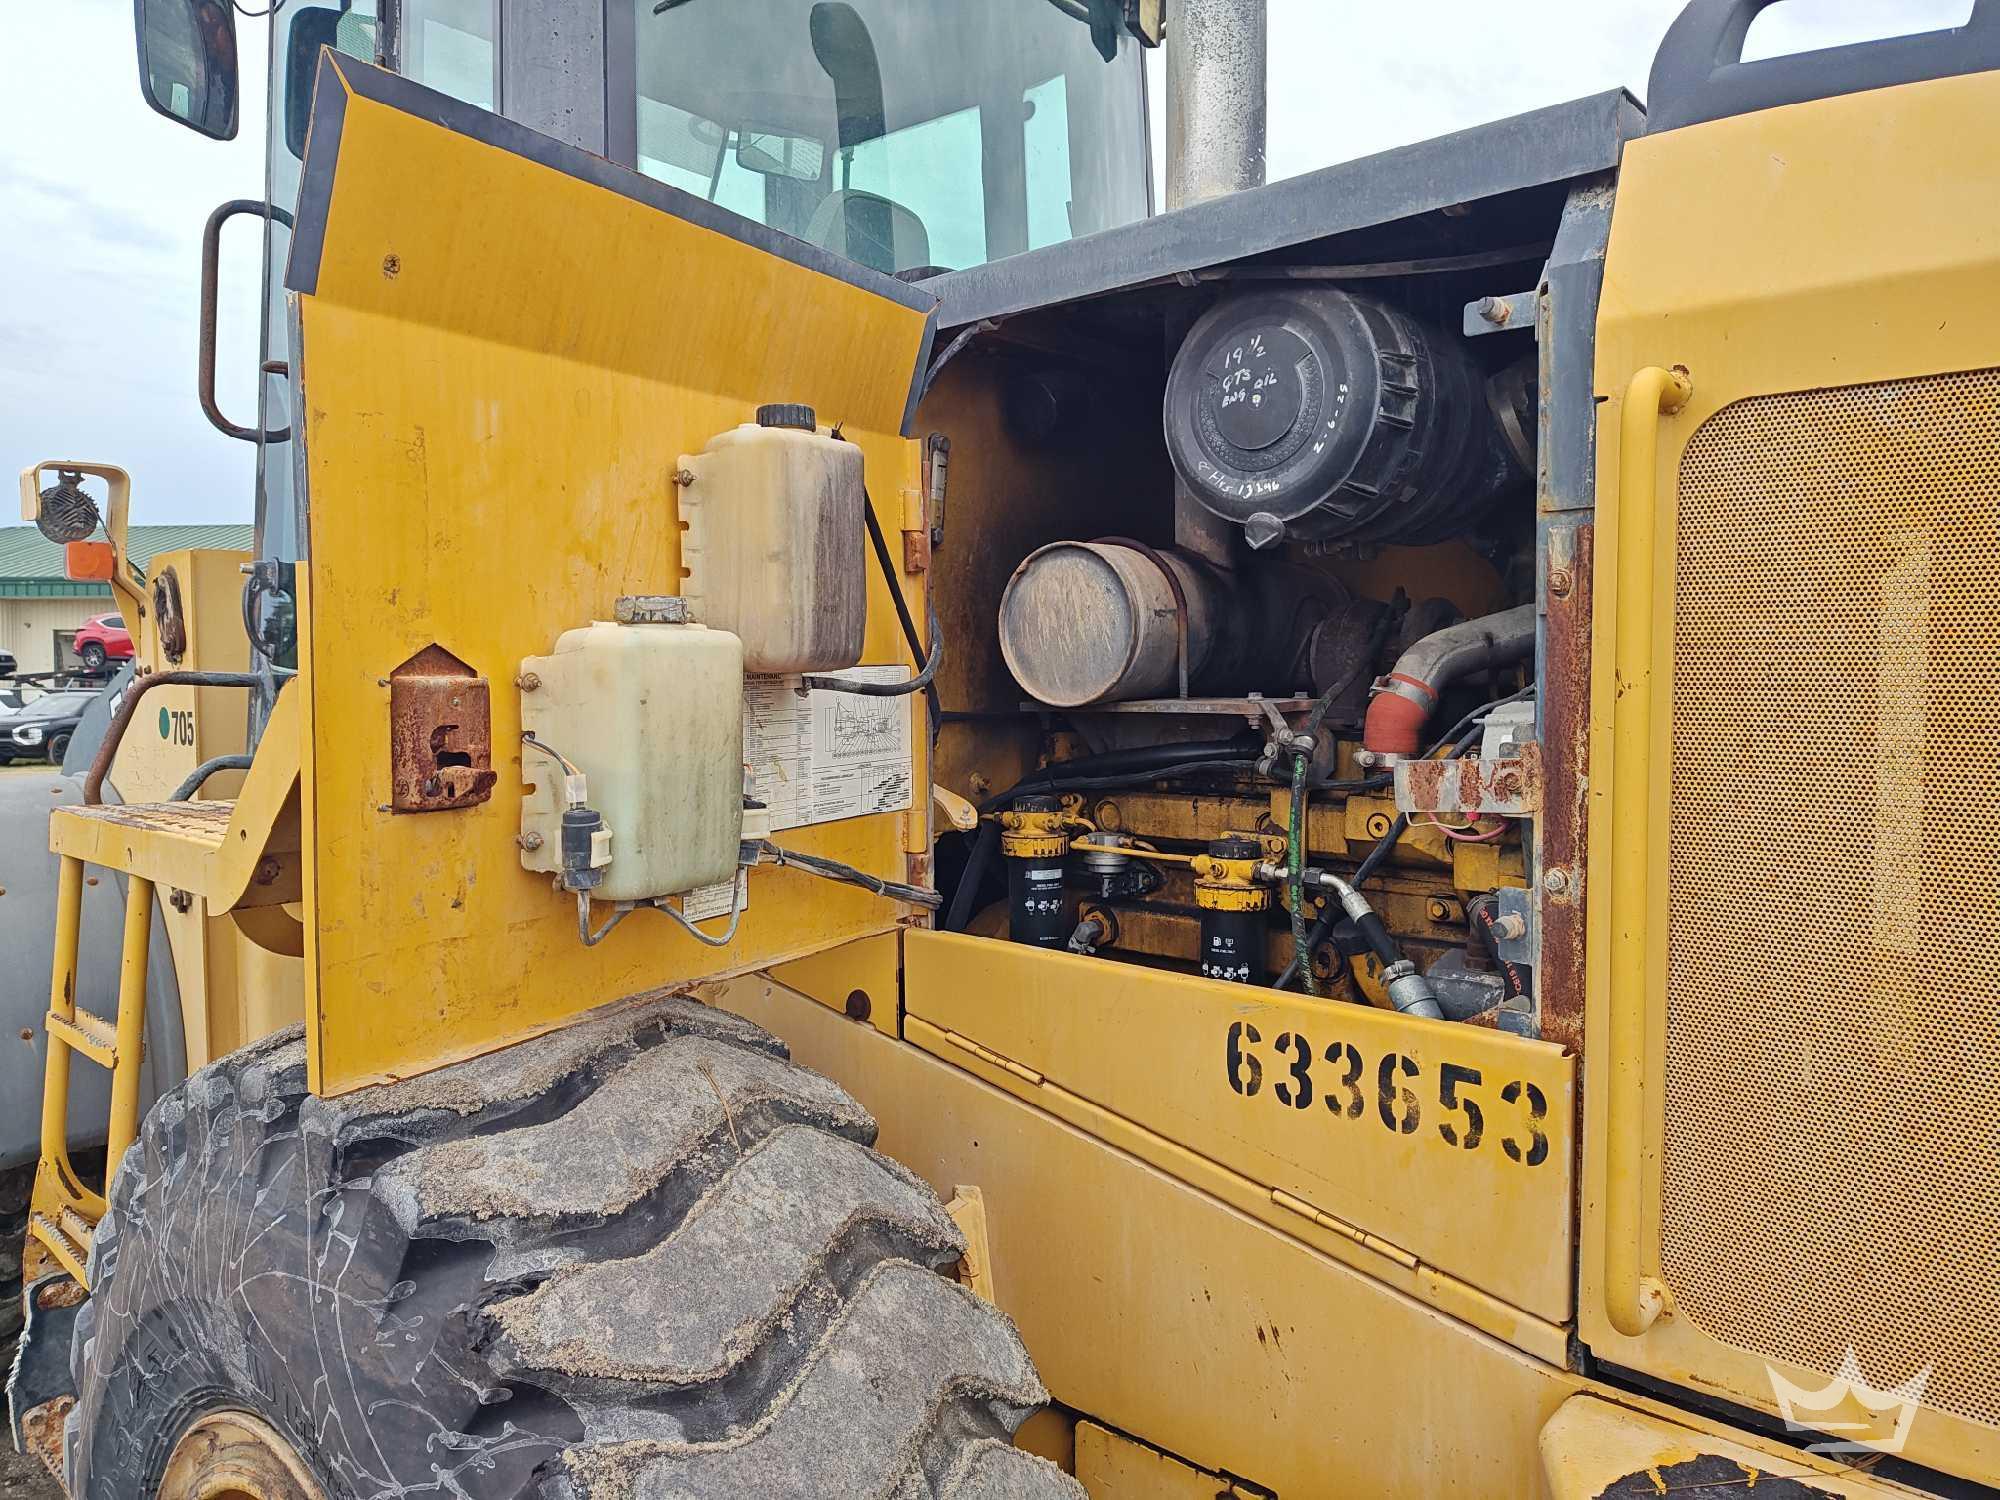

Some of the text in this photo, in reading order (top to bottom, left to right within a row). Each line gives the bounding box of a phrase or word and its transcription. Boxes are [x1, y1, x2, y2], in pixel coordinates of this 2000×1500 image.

[1225, 335, 1266, 368] 19 1/2
[1222, 368, 1251, 393] QTS
[171, 711, 194, 746] 705
[1226, 1021, 1549, 1167] 633653
